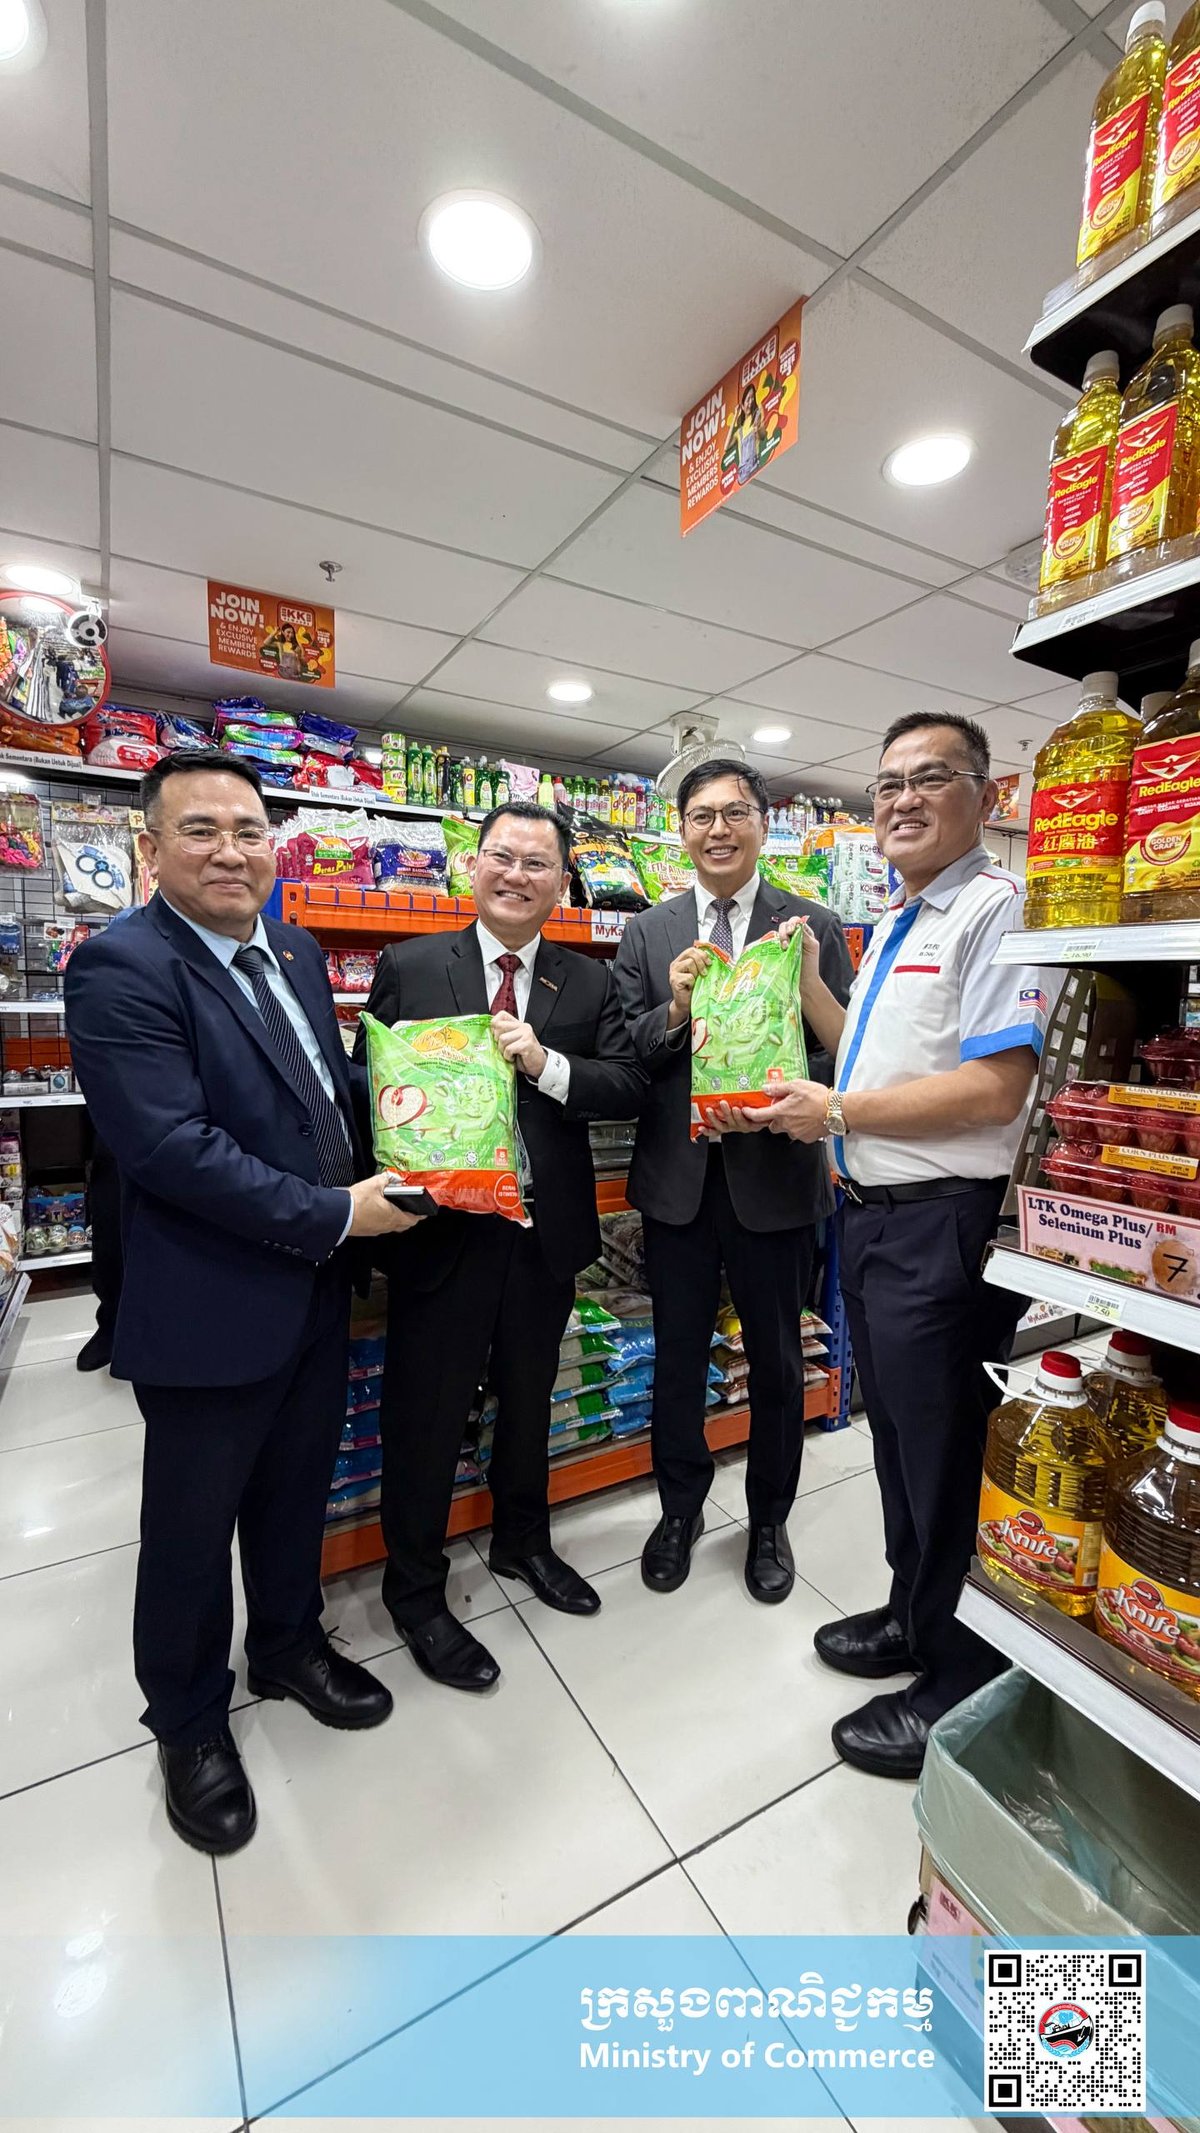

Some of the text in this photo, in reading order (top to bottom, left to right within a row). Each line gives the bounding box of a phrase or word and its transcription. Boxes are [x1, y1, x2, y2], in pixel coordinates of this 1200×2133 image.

[686, 386, 723, 438] JOIN
[681, 403, 726, 466] NOW!
[695, 440, 716, 467] ENJOY
[686, 449, 719, 487] EXCLUSIVE
[687, 463, 718, 498] MEMBERS
[687, 475, 718, 510] REWARDS
[1055, 476, 1098, 498] RedEagle
[216, 591, 260, 613] JOIN
[210, 604, 264, 629] NOW!
[216, 629, 258, 645] EXCLUSIVE
[228, 624, 254, 635] ENJOY
[218, 637, 256, 651] MEMBERS
[218, 645, 257, 659] REWARDS
[5, 753, 33, 763] Sementara
[1138, 778, 1200, 798] RedEagle
[1034, 809, 1119, 833] RedEagle
[1151, 835, 1182, 846] GOLDEN
[1028, 1197, 1177, 1239] LTK Omega Plus/ RM
[1039, 1213, 1142, 1250] Selenium Plus
[1163, 1253, 1189, 1283] 7
[1094, 1306, 1111, 1317] 7.50
[1003, 1518, 1059, 1559] Knife
[1119, 1587, 1181, 1640] Knife
